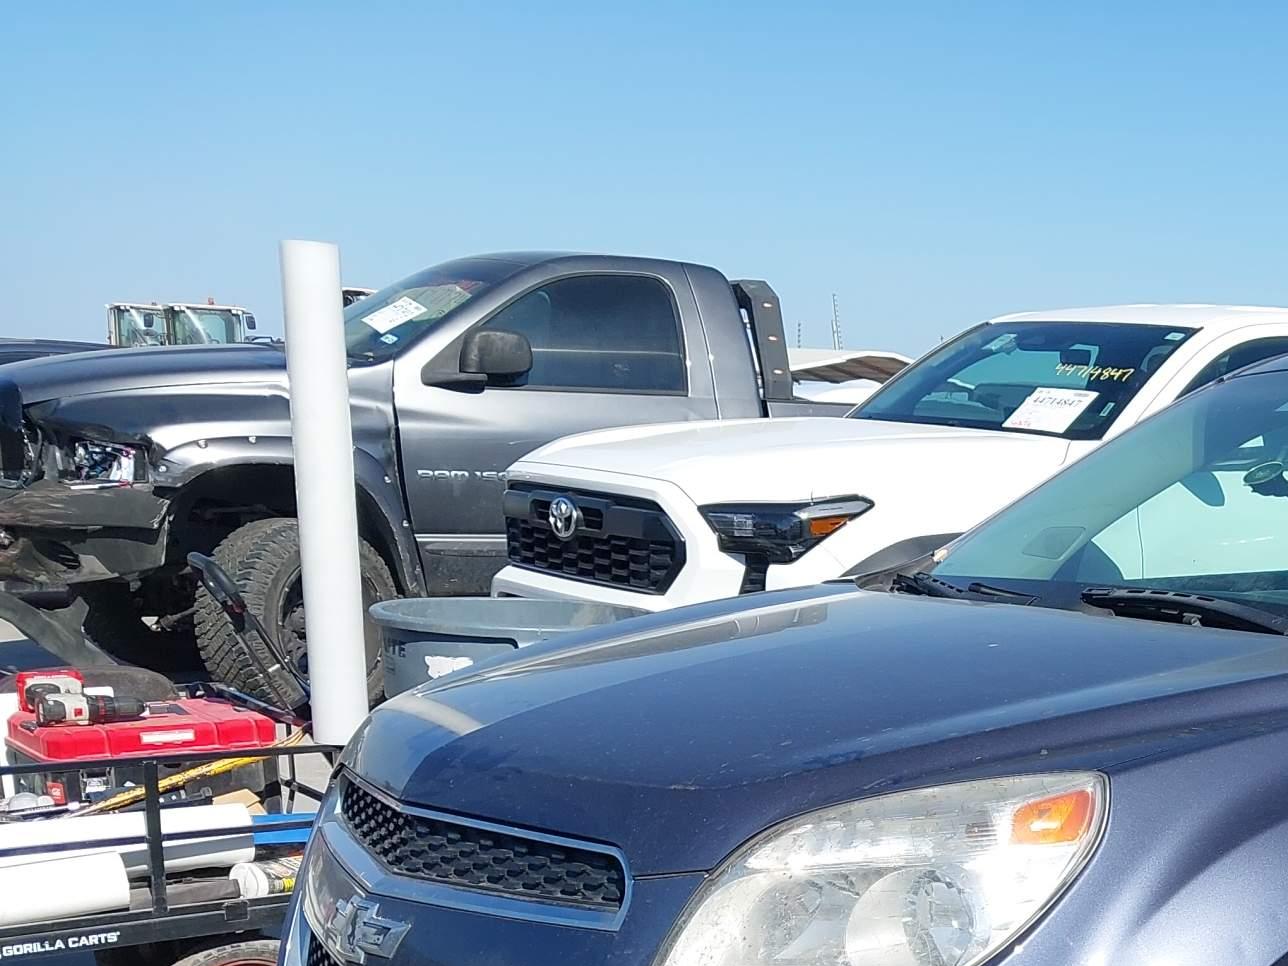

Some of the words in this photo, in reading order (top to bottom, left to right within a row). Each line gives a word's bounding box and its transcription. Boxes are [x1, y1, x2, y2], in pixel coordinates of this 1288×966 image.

[1055, 363, 1136, 382] 44714847
[2, 939, 66, 957] GORILLA
[67, 931, 118, 948] CARTS
